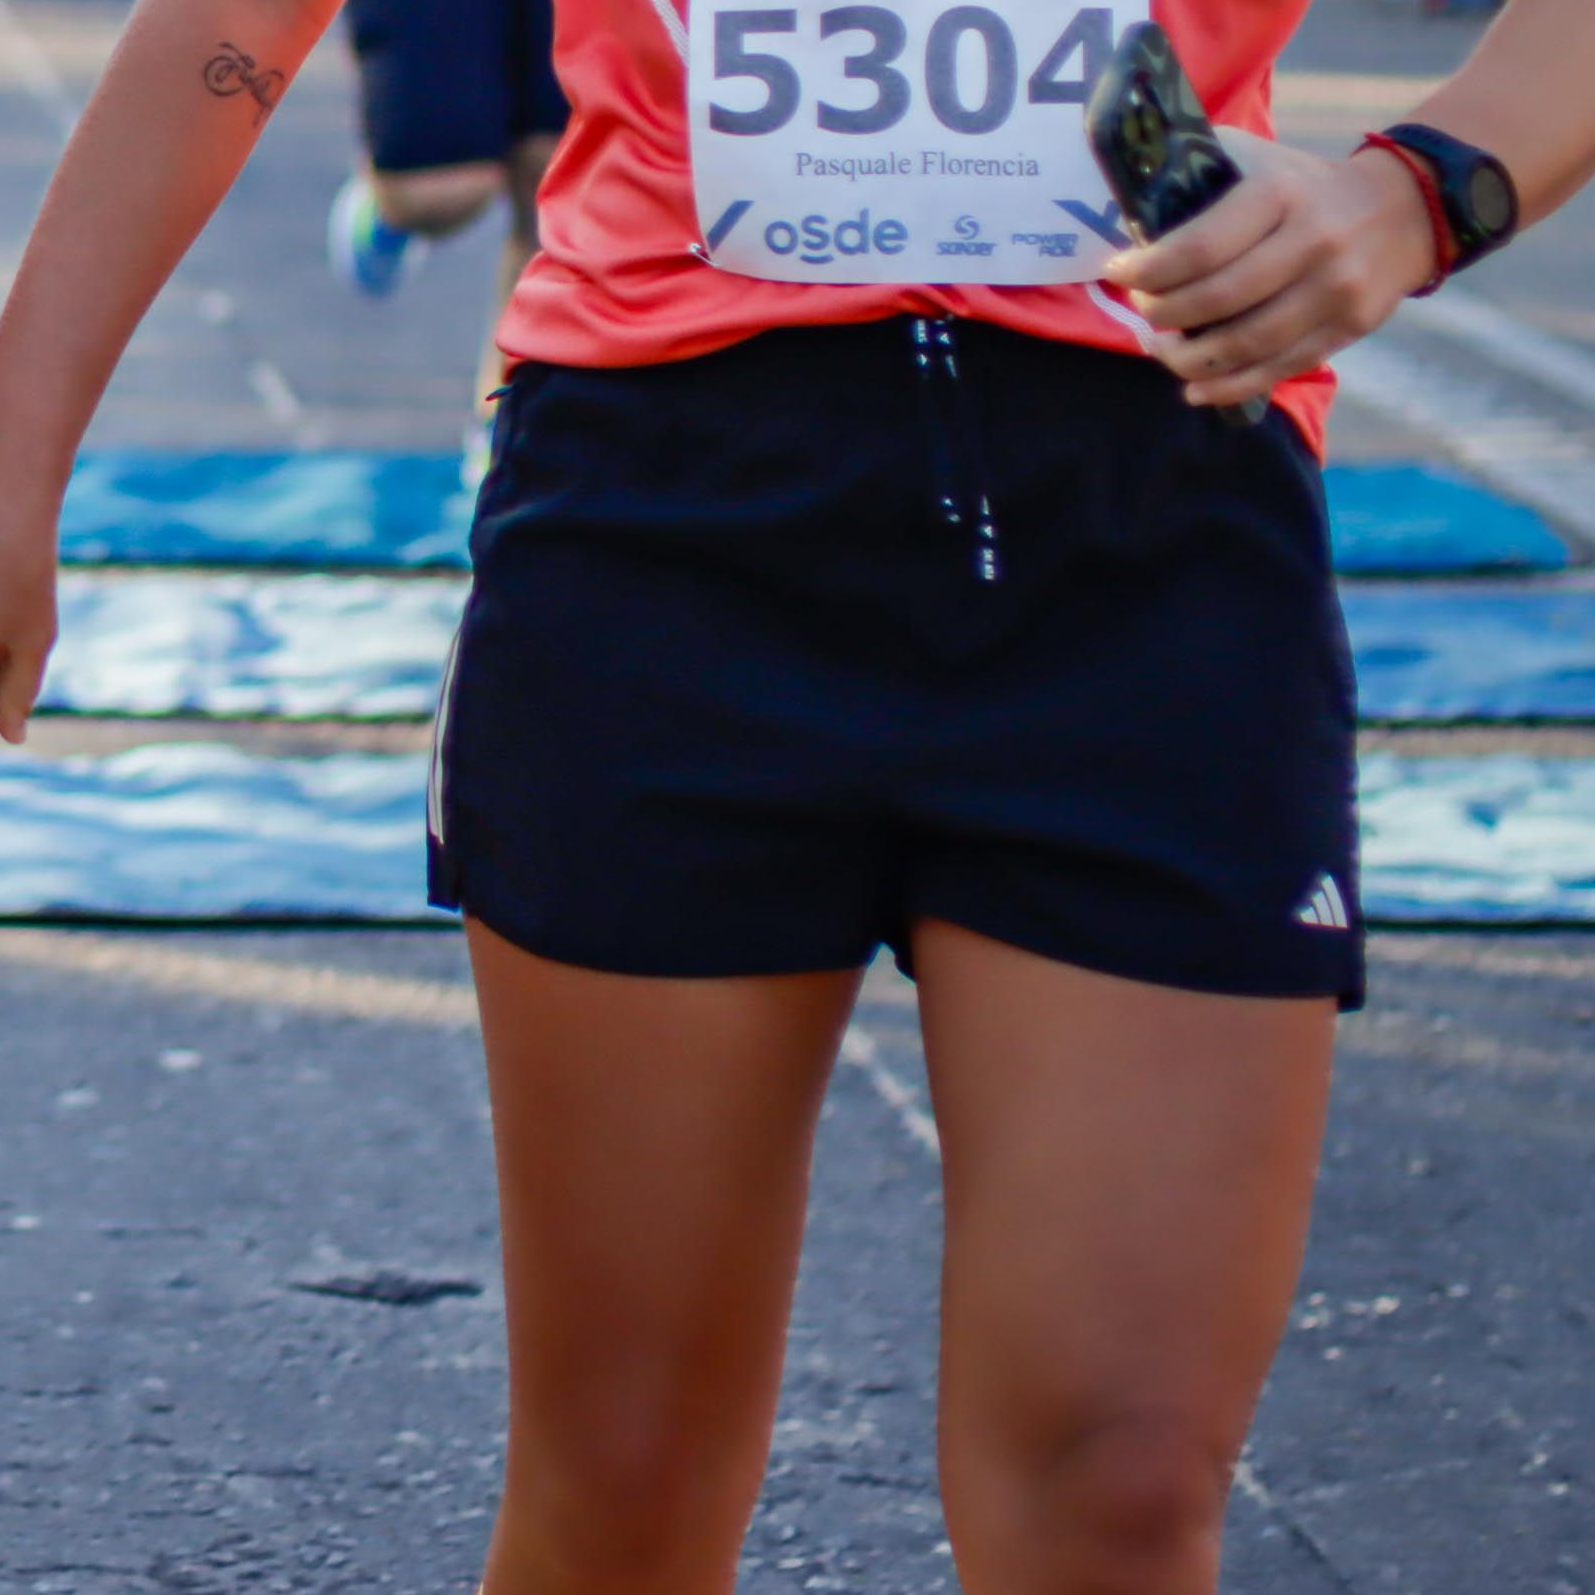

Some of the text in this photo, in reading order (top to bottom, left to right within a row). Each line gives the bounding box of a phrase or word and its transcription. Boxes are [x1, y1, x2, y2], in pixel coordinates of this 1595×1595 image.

[708, 5, 1116, 136] 5304
[795, 151, 1039, 182] Pasquale Florencia
[764, 208, 908, 257] osde
